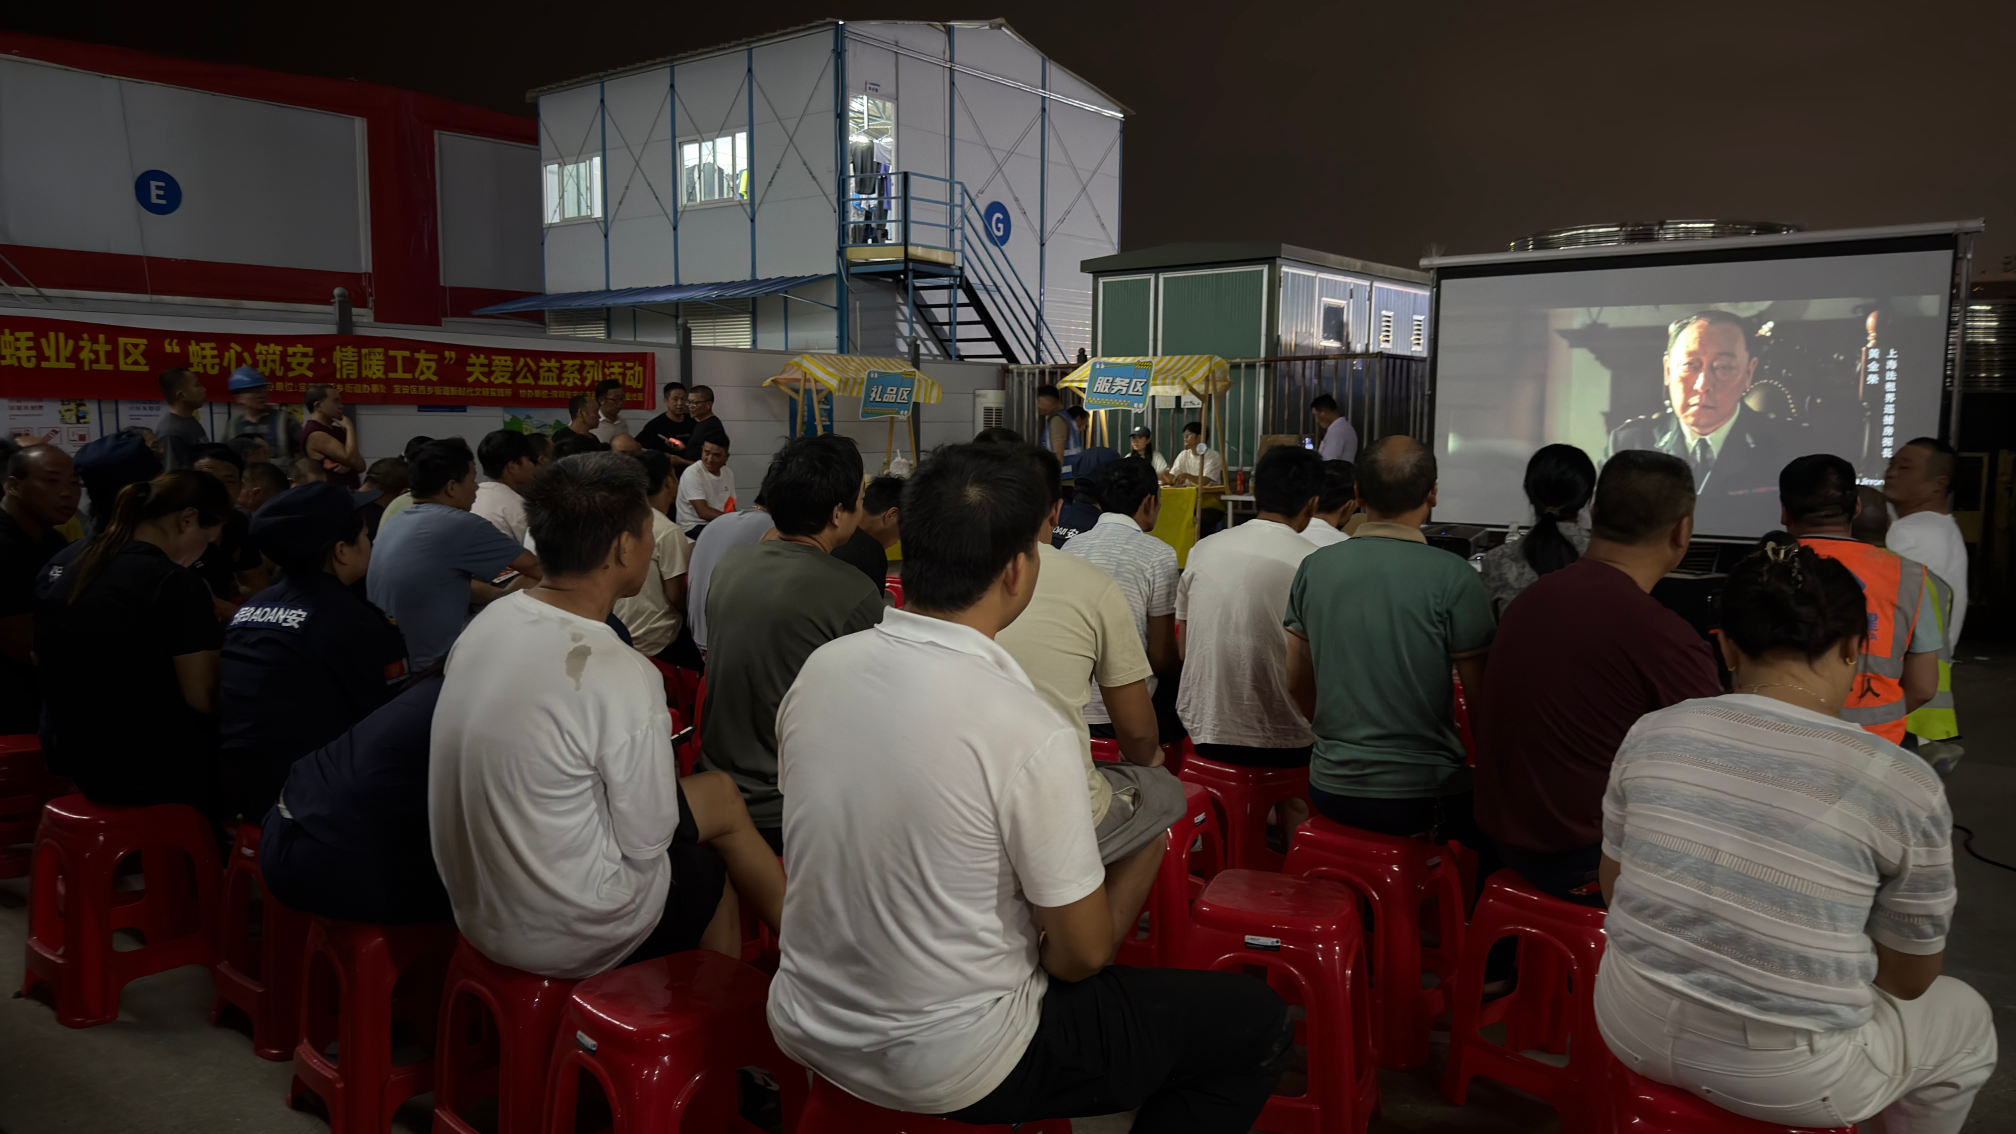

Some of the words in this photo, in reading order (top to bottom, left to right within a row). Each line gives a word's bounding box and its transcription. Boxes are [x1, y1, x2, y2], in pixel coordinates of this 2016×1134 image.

[149, 180, 167, 205] E
[991, 212, 1004, 237] G
[869, 385, 912, 404] 礼品区
[1093, 376, 1147, 396] 服务区
